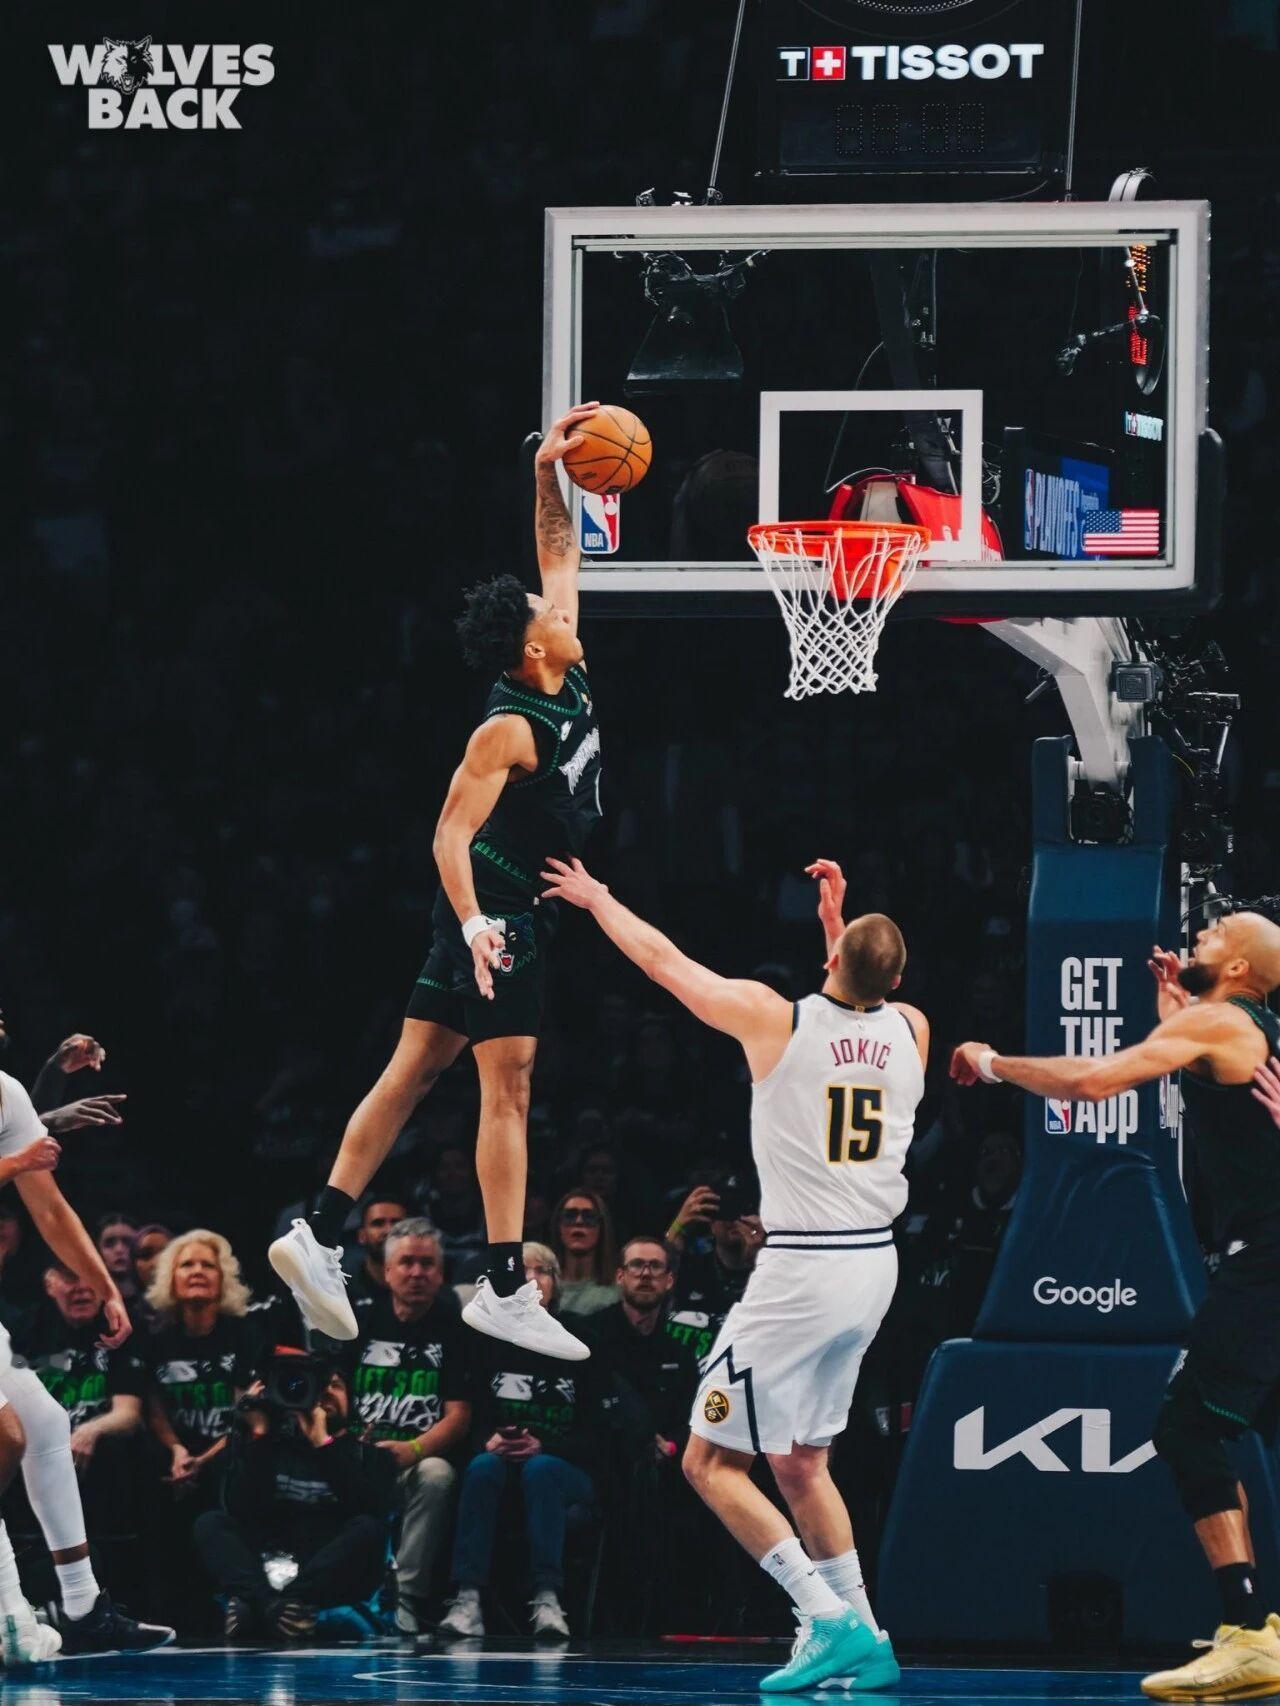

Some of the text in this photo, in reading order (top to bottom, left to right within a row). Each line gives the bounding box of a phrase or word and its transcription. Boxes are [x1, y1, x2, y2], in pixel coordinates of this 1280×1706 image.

[851, 43, 1045, 80] TISSOT
[584, 532, 605, 548] NBA
[1061, 956, 1123, 1011] GET
[830, 1037, 892, 1070] JOKIĆ
[826, 1083, 885, 1163] 15
[1033, 1276, 1138, 1314] Google
